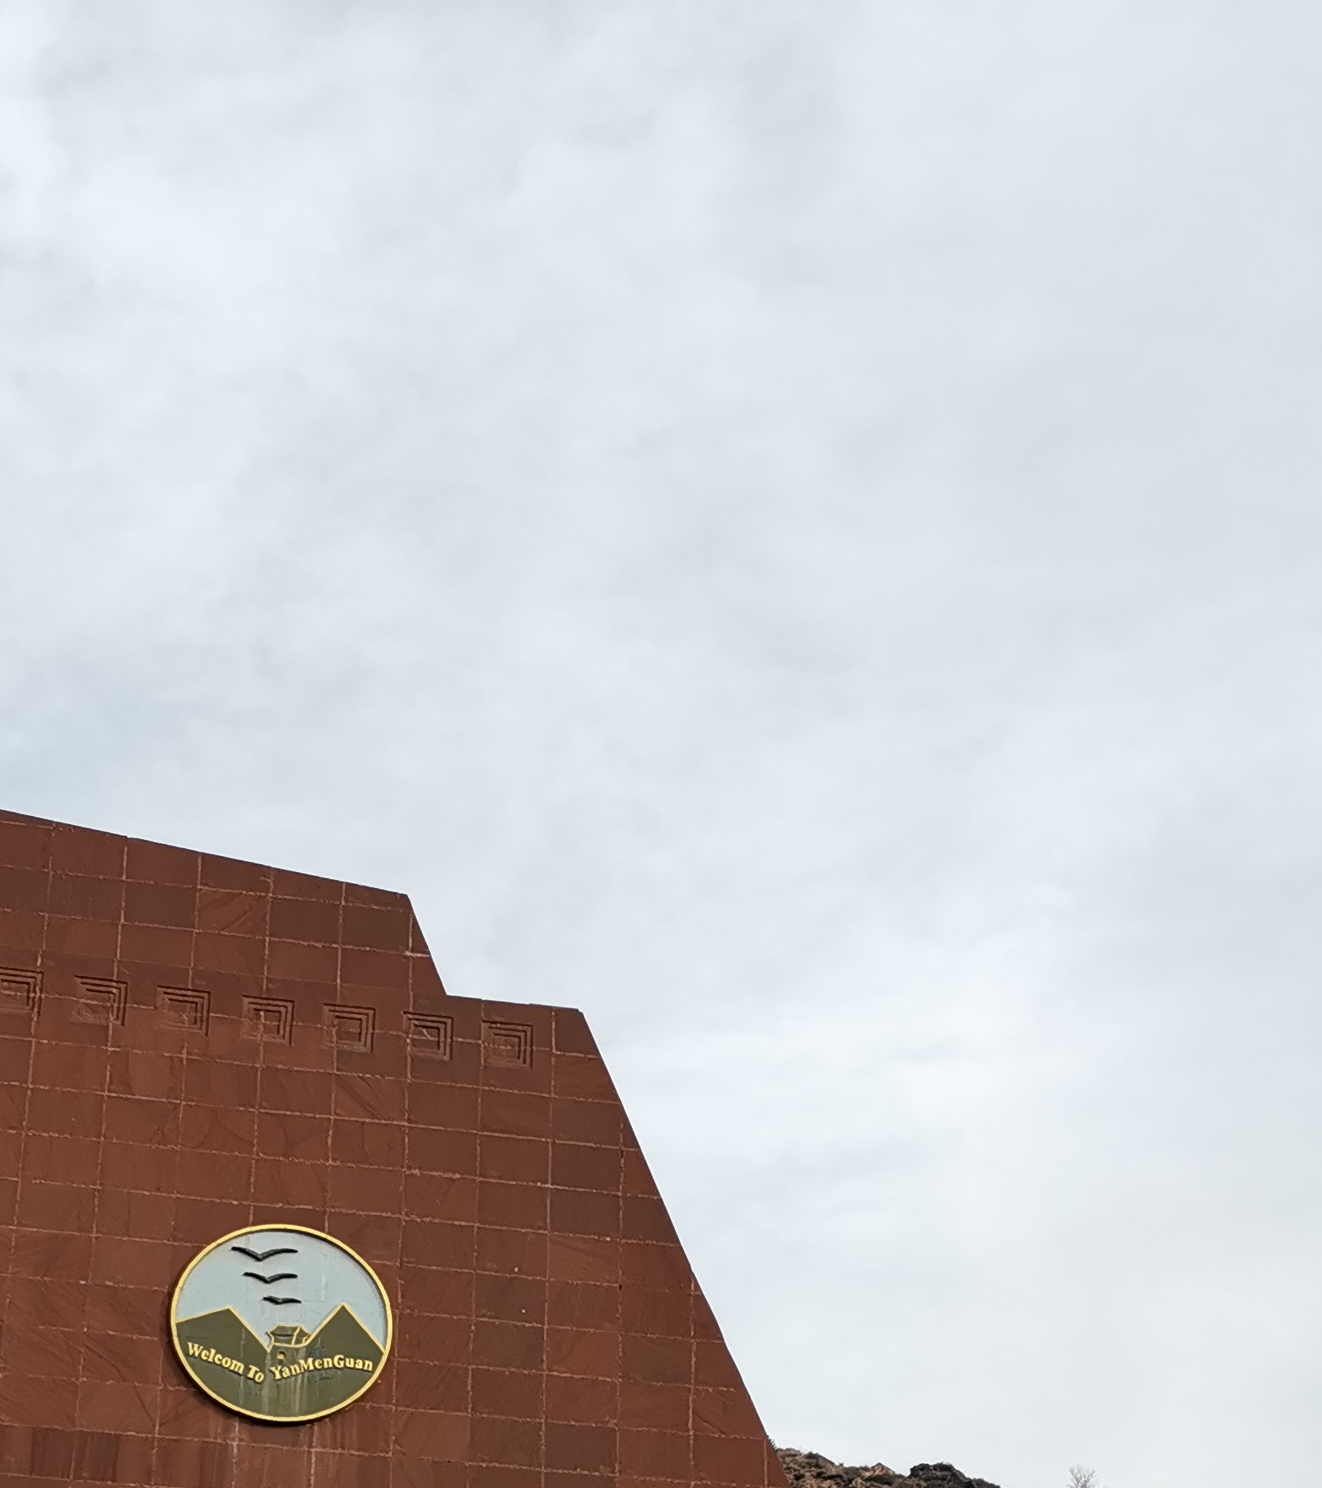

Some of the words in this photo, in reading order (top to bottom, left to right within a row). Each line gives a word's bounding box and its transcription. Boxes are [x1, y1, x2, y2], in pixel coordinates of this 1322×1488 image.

[187, 1341, 244, 1375] Welcom
[247, 1366, 265, 1384] To
[270, 1353, 374, 1381] YanMenGuan
